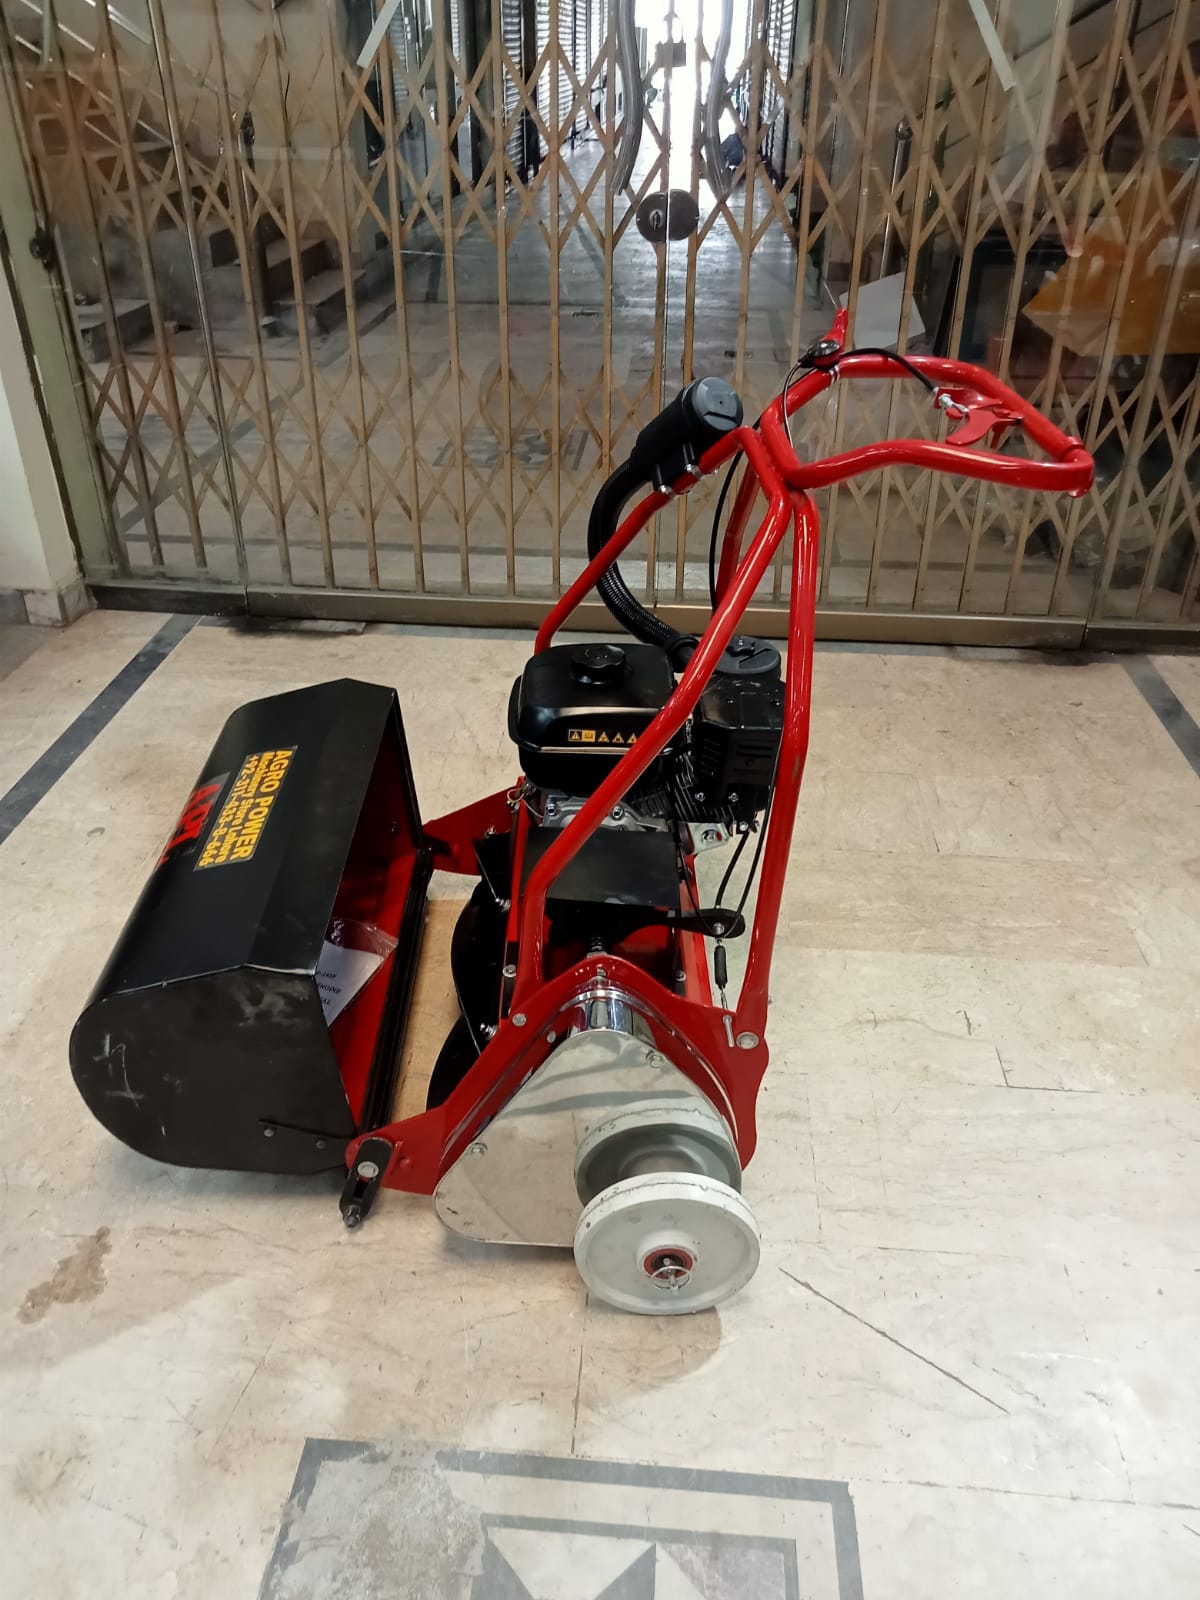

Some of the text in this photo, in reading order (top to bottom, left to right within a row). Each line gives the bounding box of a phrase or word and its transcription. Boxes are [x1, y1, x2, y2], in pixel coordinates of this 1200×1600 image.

[215, 752, 275, 864] Machinery Store Lahore
[230, 750, 293, 861] AGRO POWER
